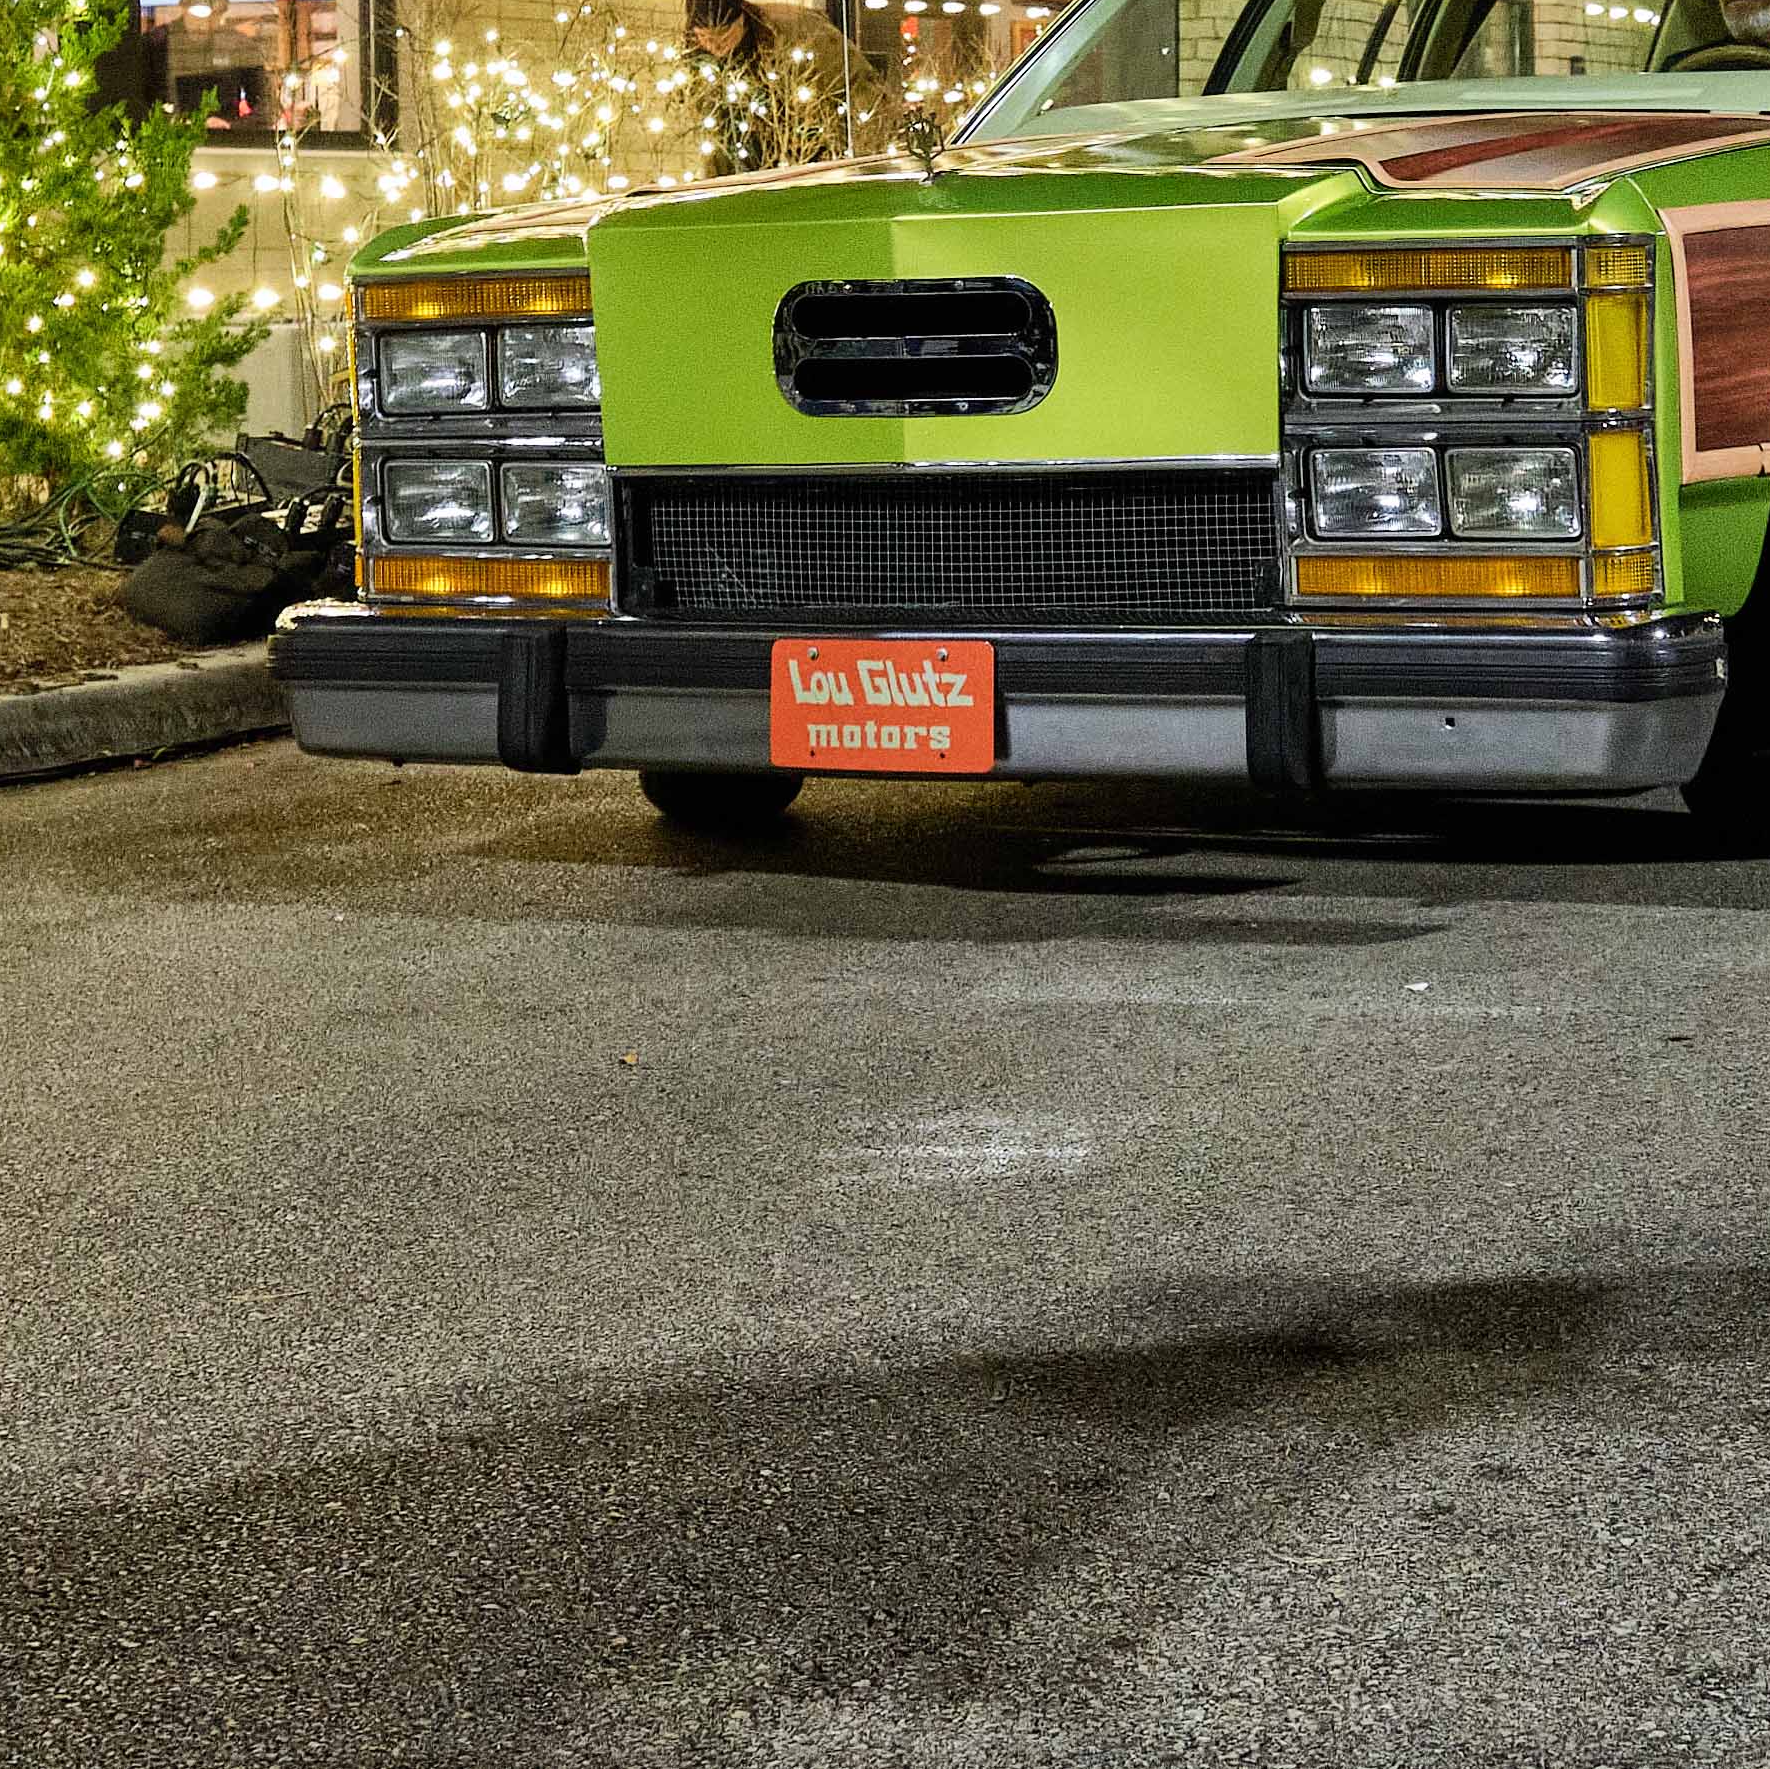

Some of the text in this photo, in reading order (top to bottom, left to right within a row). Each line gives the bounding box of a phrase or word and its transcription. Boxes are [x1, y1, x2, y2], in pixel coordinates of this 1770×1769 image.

[788, 659, 974, 707] Lou Glutz
[807, 720, 951, 749] motors
